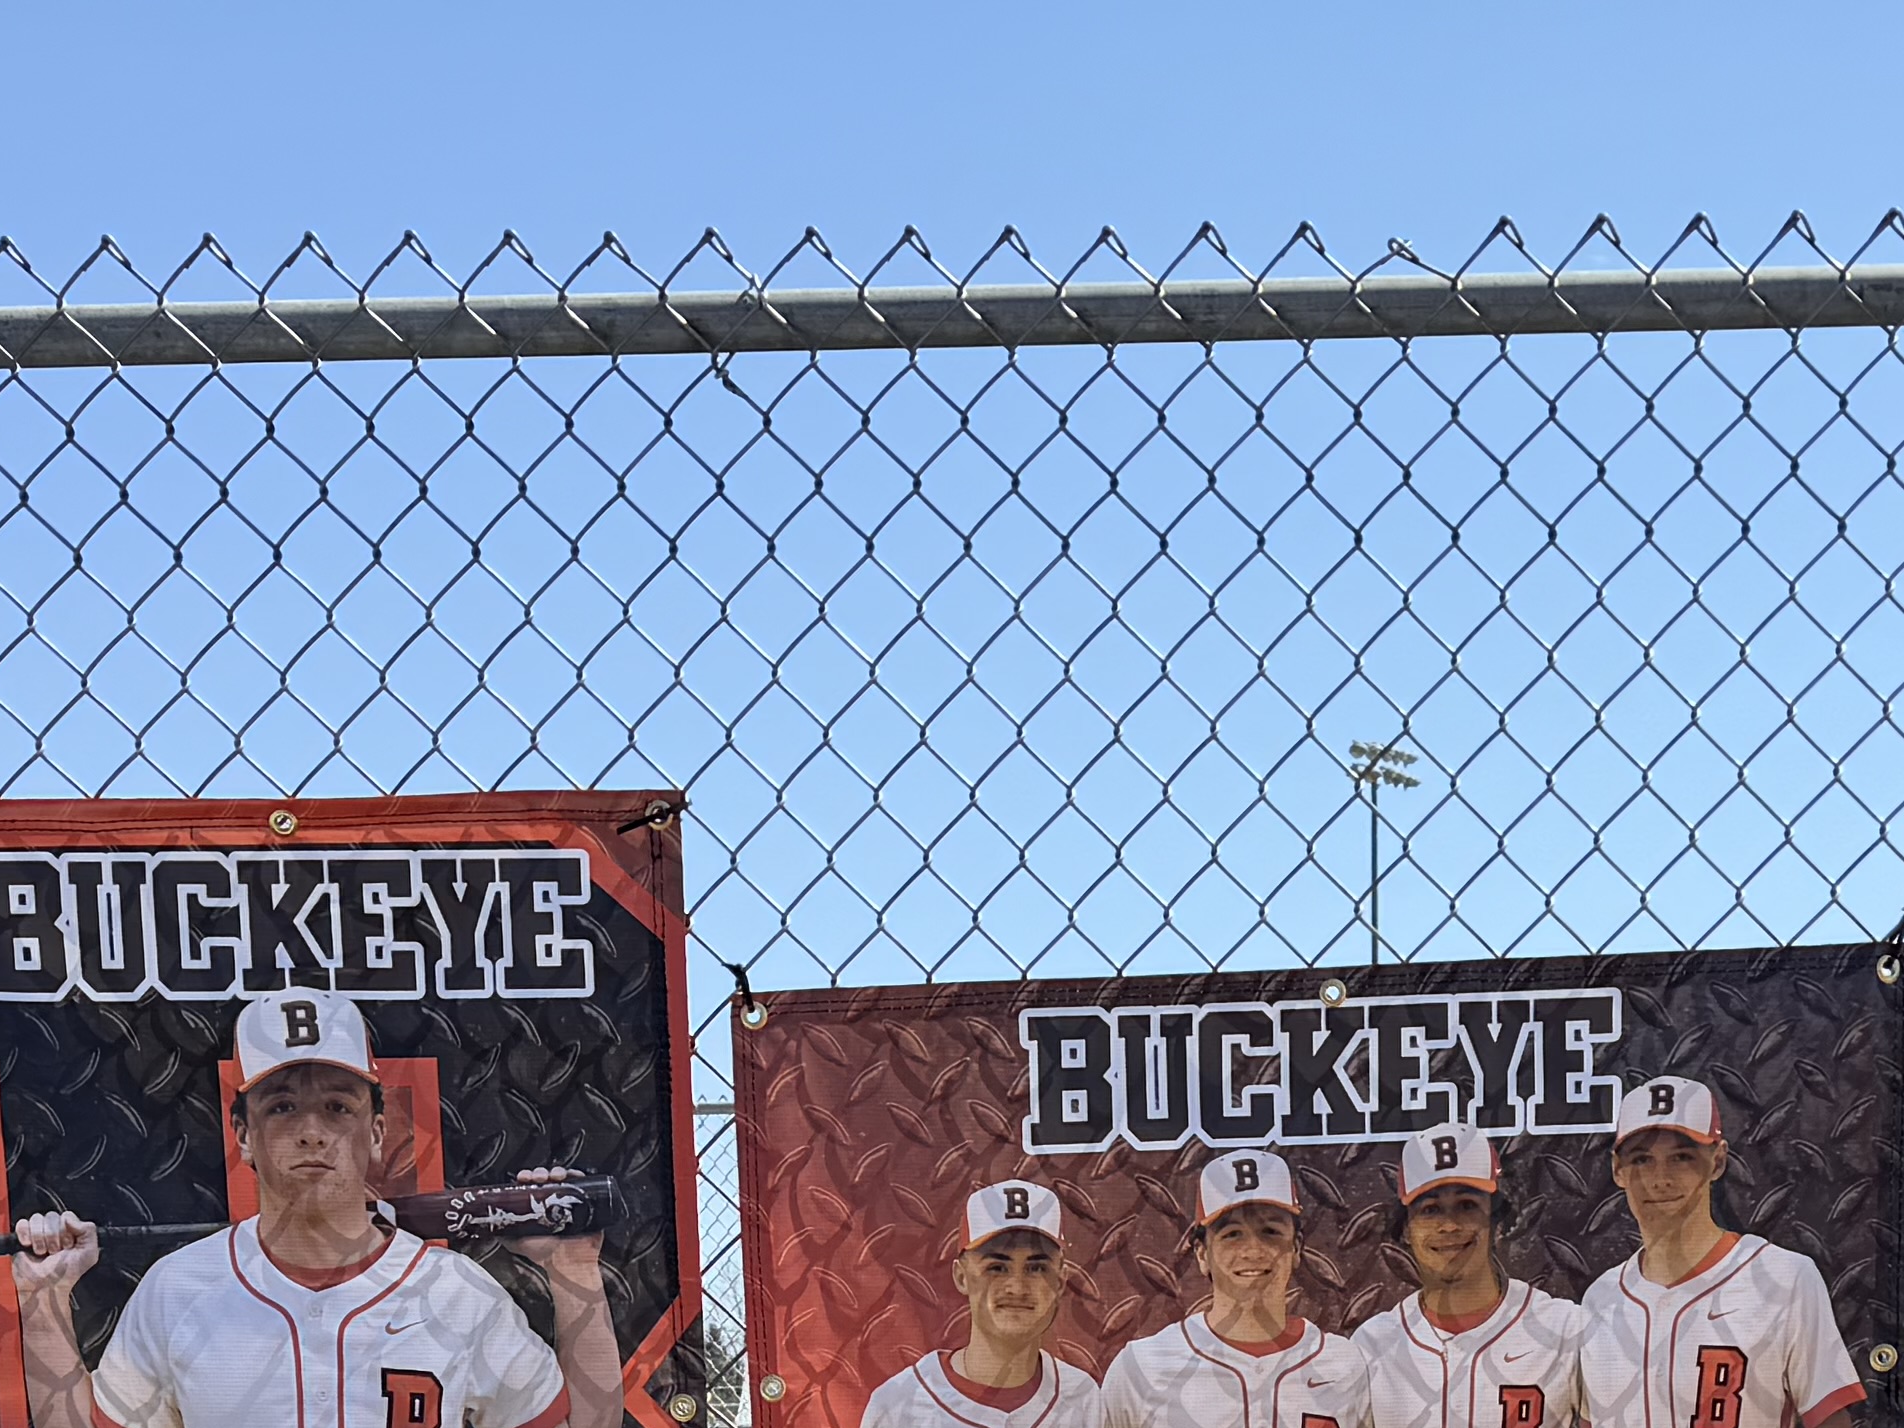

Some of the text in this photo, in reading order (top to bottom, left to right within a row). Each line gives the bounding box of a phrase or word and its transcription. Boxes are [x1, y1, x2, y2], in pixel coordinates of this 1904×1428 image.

[280, 1000, 322, 1048] B
[1018, 987, 1622, 1155] BUCKEYE
[1647, 1083, 1675, 1117] B
[1433, 1134, 1459, 1172] B
[1232, 1158, 1260, 1192] B
[1004, 1187, 1031, 1220] B
